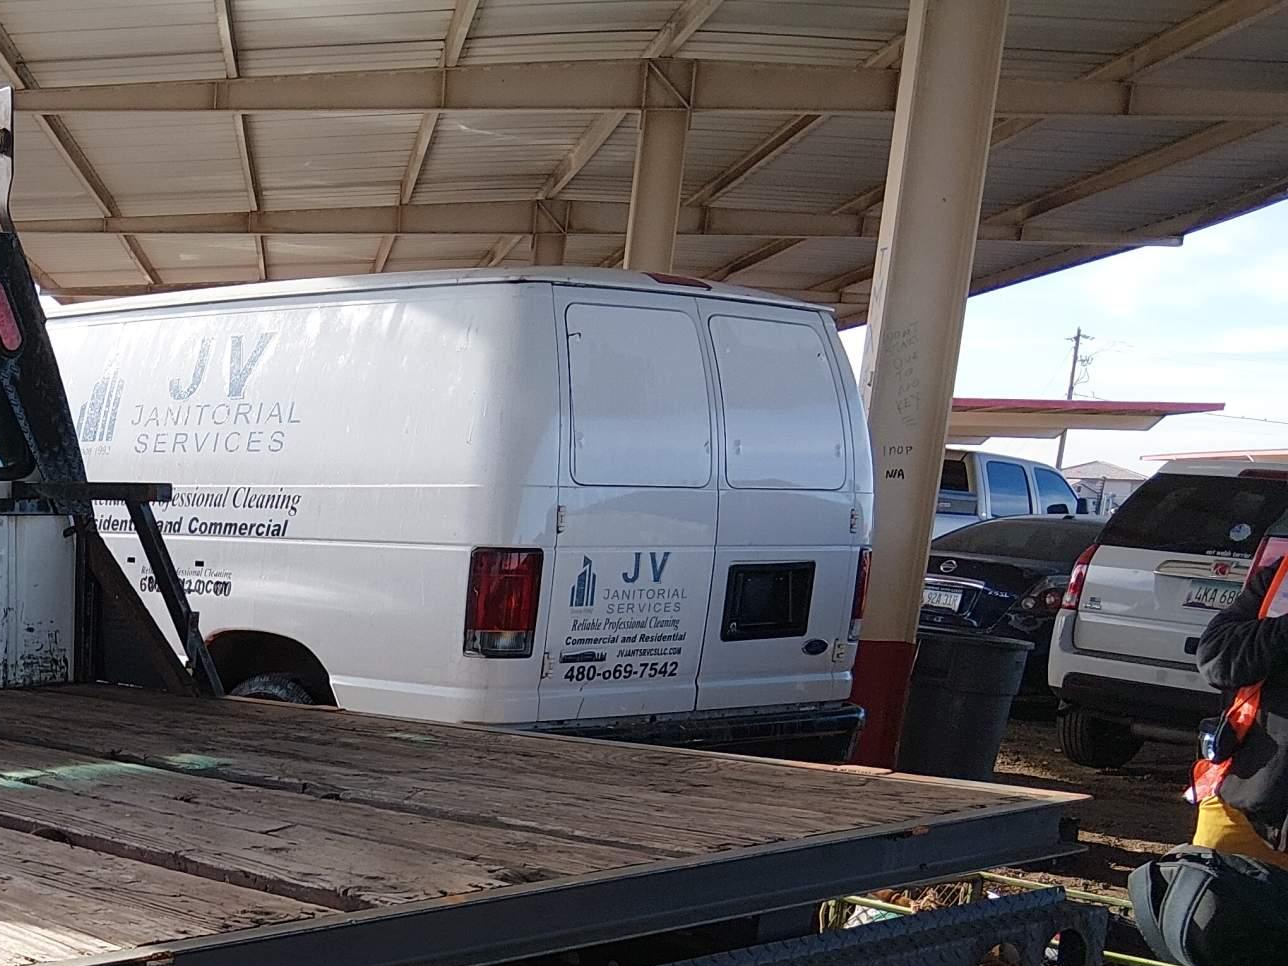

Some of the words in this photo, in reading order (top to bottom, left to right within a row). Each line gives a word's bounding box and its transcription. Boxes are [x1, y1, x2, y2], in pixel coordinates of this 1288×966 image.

[169, 332, 277, 400] JV
[131, 401, 302, 427] JANITORIAL
[134, 431, 286, 454] SERVICES
[885, 468, 905, 480] N/A
[232, 486, 302, 516] Cleaning
[156, 516, 184, 534] and
[188, 516, 289, 537] Commercial
[622, 552, 671, 583] JV
[603, 588, 687, 600] JANITORIAL
[606, 602, 681, 614] SERVICES
[571, 618, 602, 632] Reliable
[602, 616, 649, 633] Professional
[649, 615, 680, 630] Cleaning
[565, 634, 619, 646] Commercial
[620, 633, 637, 643] and
[638, 632, 687, 643] Residential
